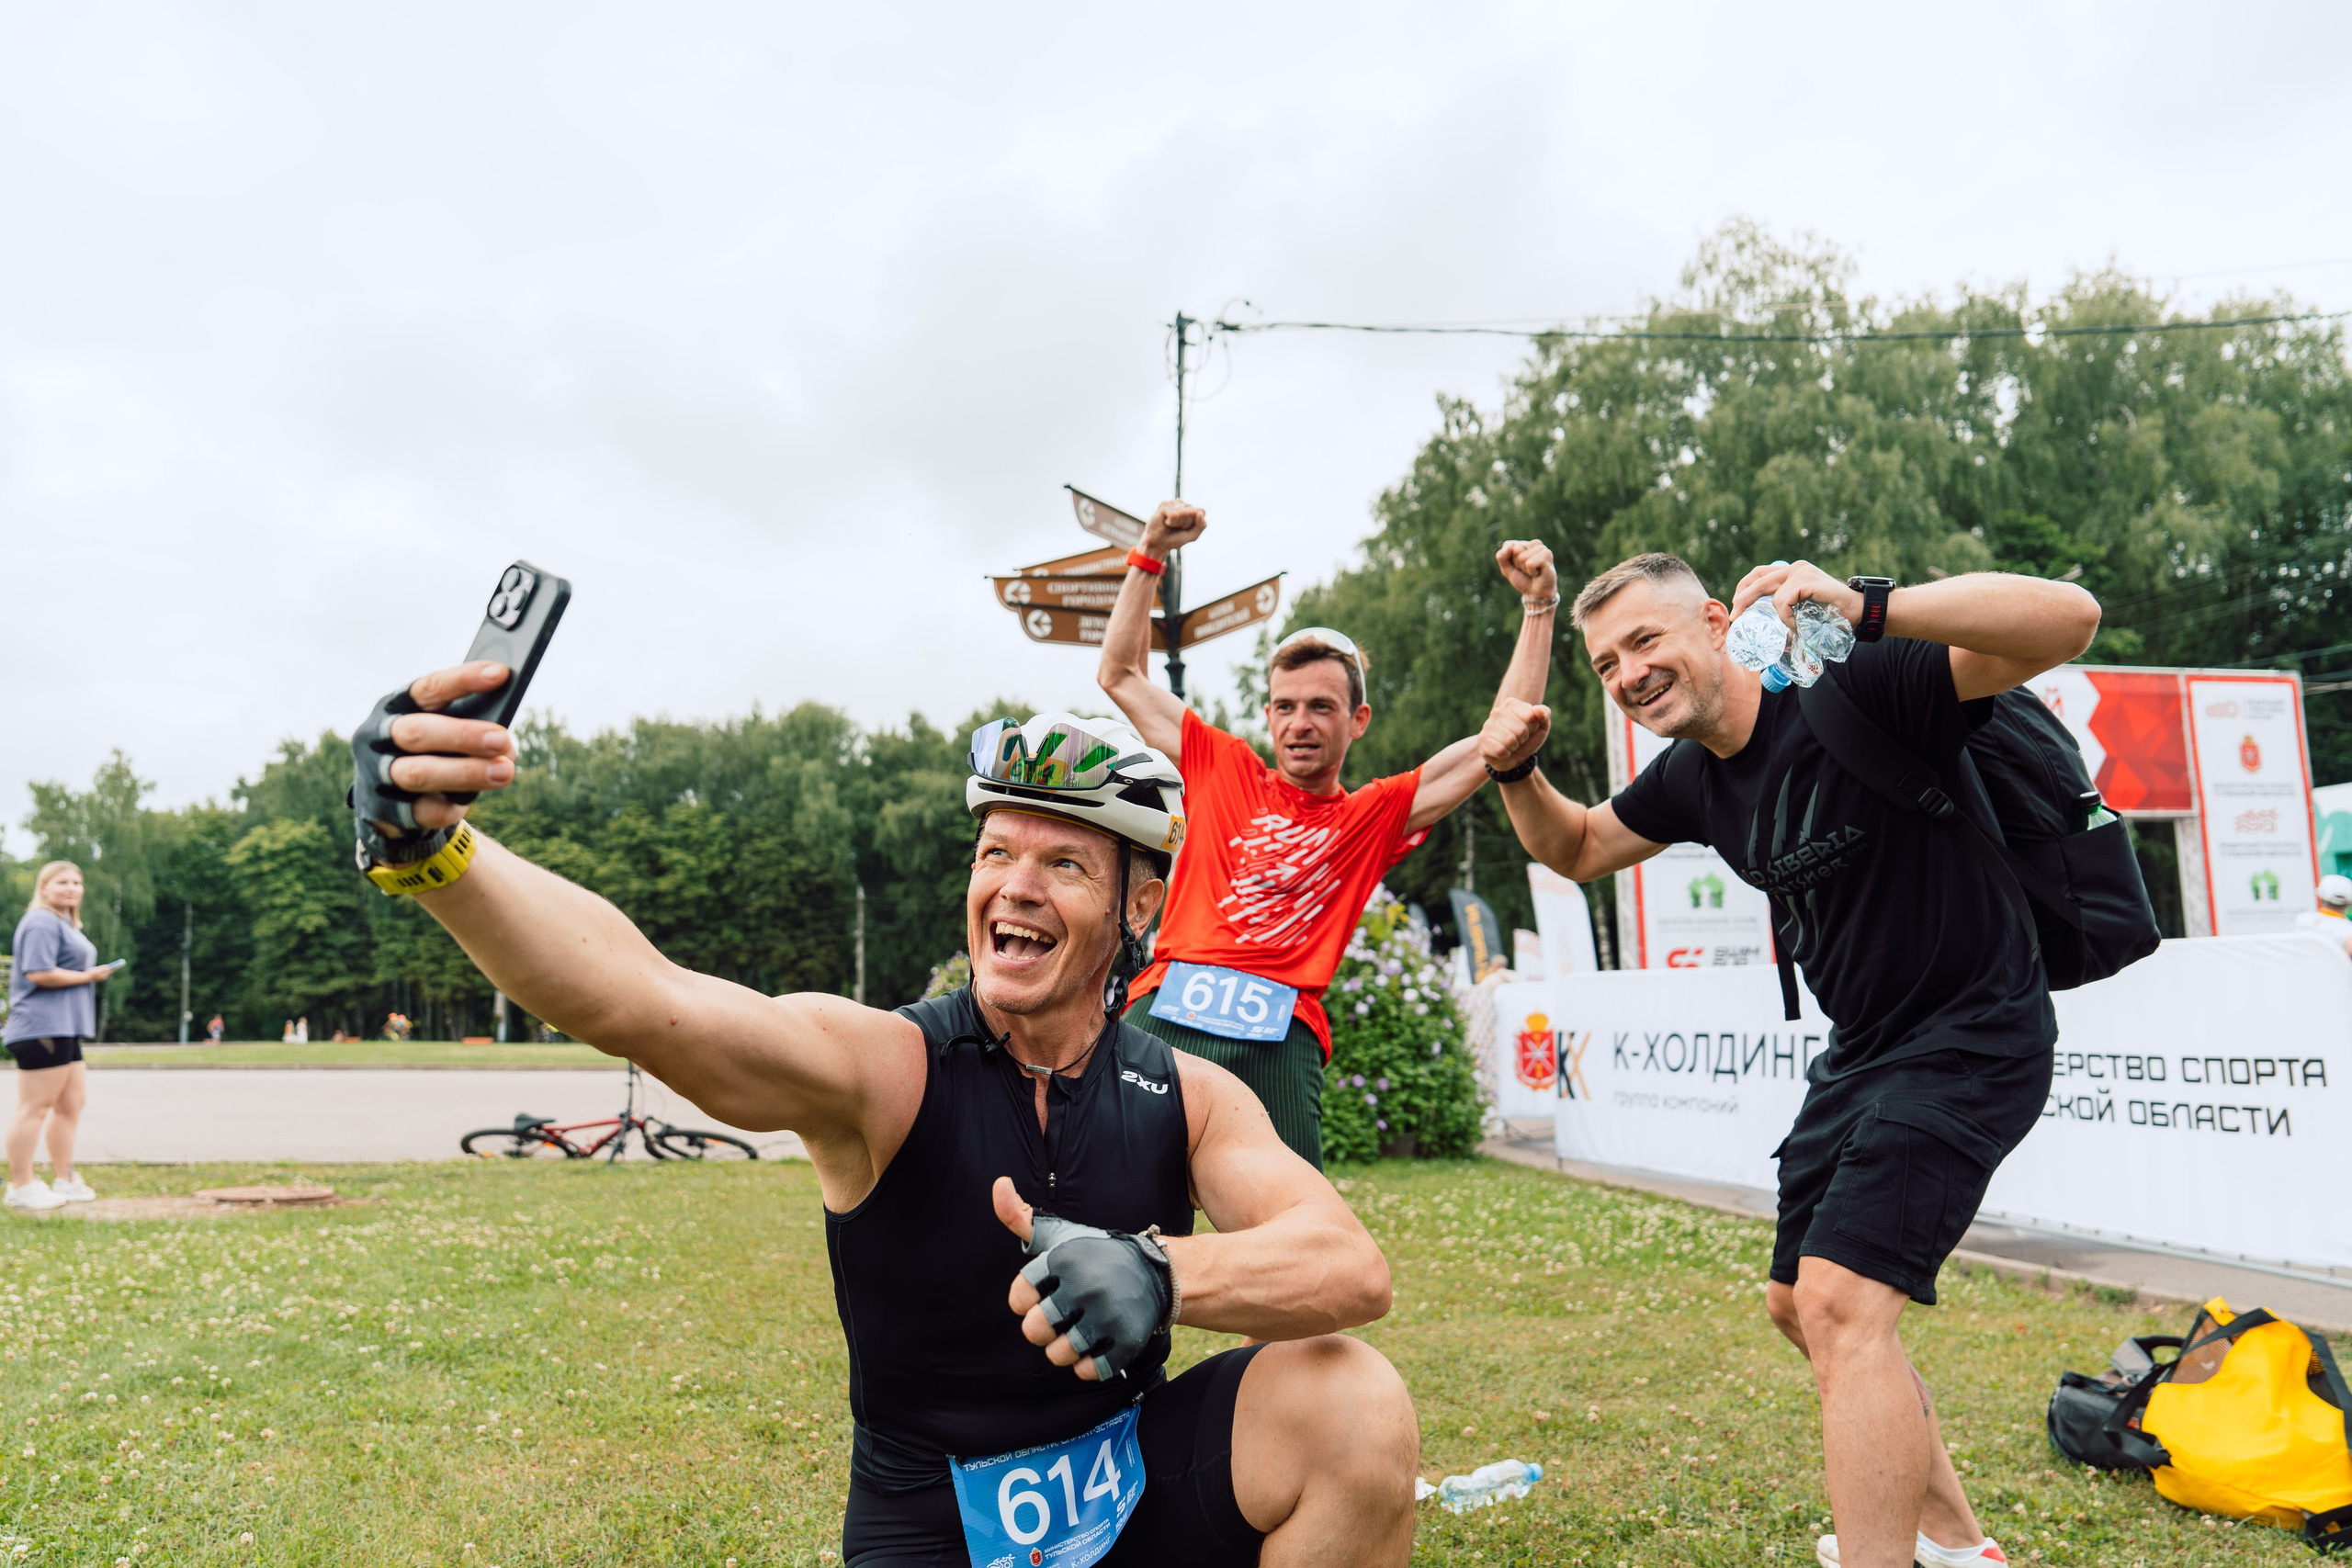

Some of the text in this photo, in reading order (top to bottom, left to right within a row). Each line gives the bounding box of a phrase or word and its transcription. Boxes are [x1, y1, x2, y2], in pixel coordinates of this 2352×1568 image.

[1168, 820, 1185, 846] 614
[1182, 971, 1273, 1024] 615
[1613, 1032, 1821, 1084] К-ХОЛДИНГ
[2053, 1053, 2328, 1088] ЕРСТВО СПОРТА
[1120, 1070, 1169, 1095] 2XU
[2129, 1100, 2291, 1136] ОБЛАСТИ
[964, 1451, 1013, 1472] ТУЛЬСКОЙ
[998, 1438, 1122, 1546] 614
[1045, 1540, 1082, 1560] ТУЛЬСКОЙ
[1081, 1521, 1111, 1545] ОБЛАСТИ
[1070, 1535, 1112, 1568] К-ХОЛДИНГ
